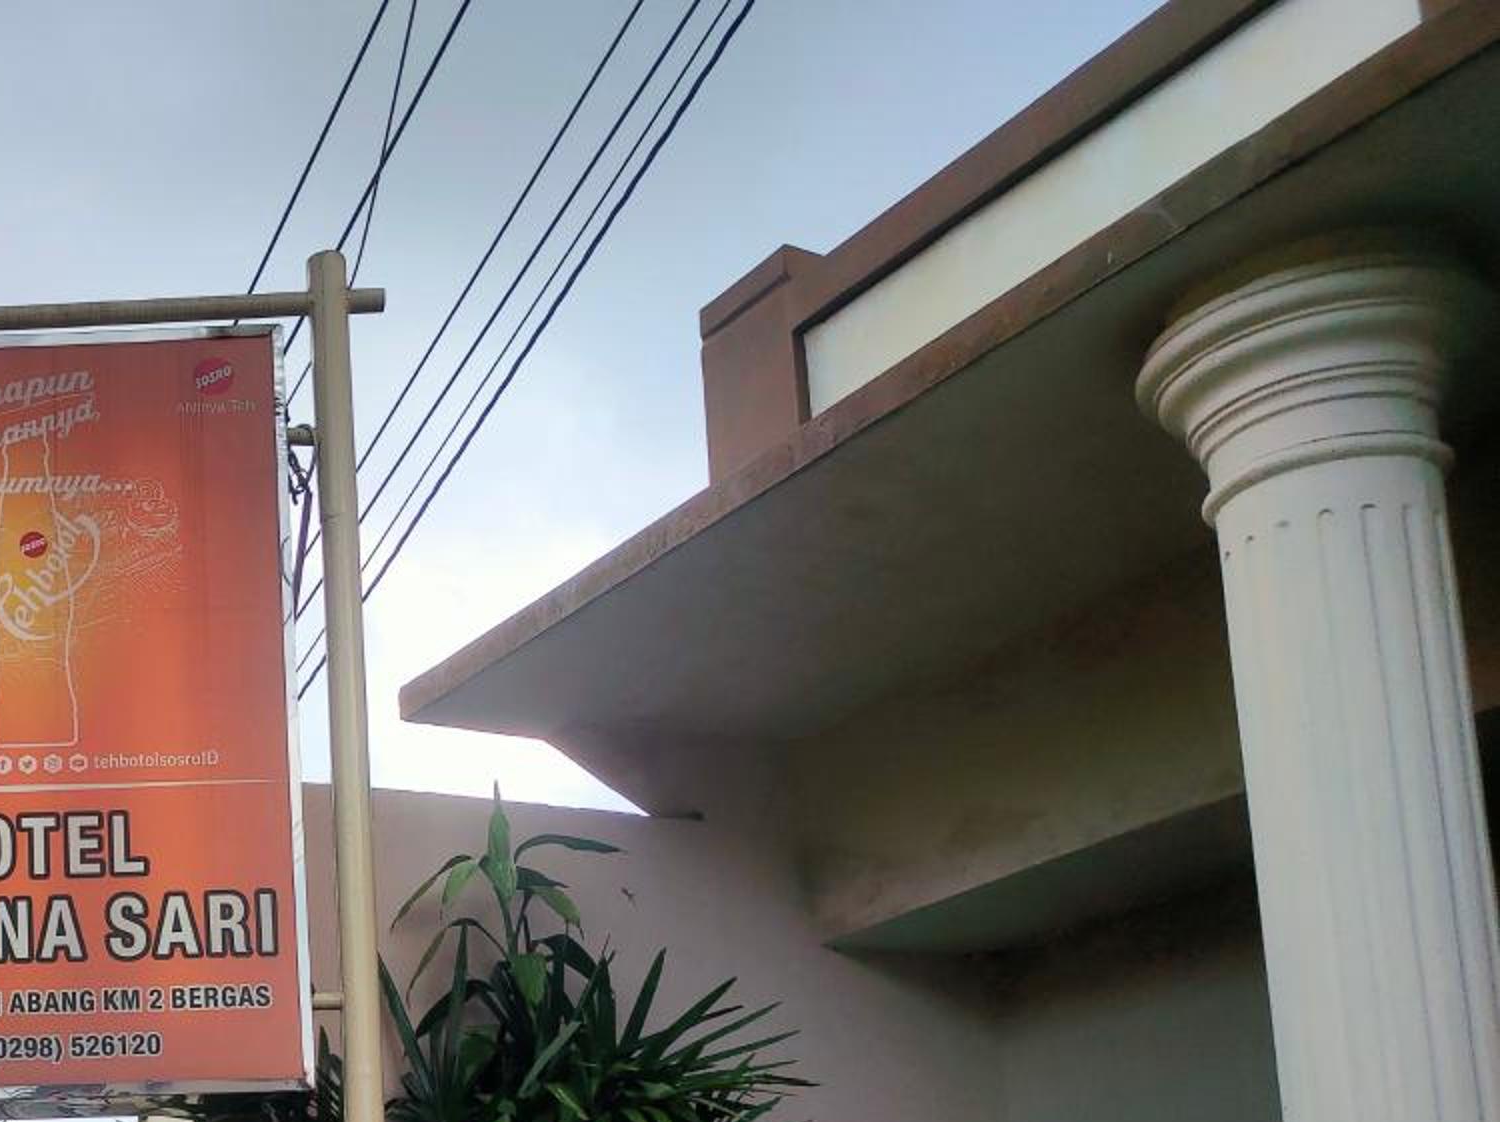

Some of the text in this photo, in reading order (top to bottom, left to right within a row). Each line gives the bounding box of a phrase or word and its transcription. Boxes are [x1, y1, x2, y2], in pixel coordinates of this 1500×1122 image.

[196, 366, 232, 389] SOSRO
[94, 751, 219, 770] tehbotolsosroID
[106, 889, 280, 962] SARI
[9, 989, 95, 1013] ABANG
[103, 988, 140, 1011] KM
[148, 987, 164, 1010] 2
[171, 985, 271, 1009] BERGAS
[70, 1033, 162, 1058] 526120
